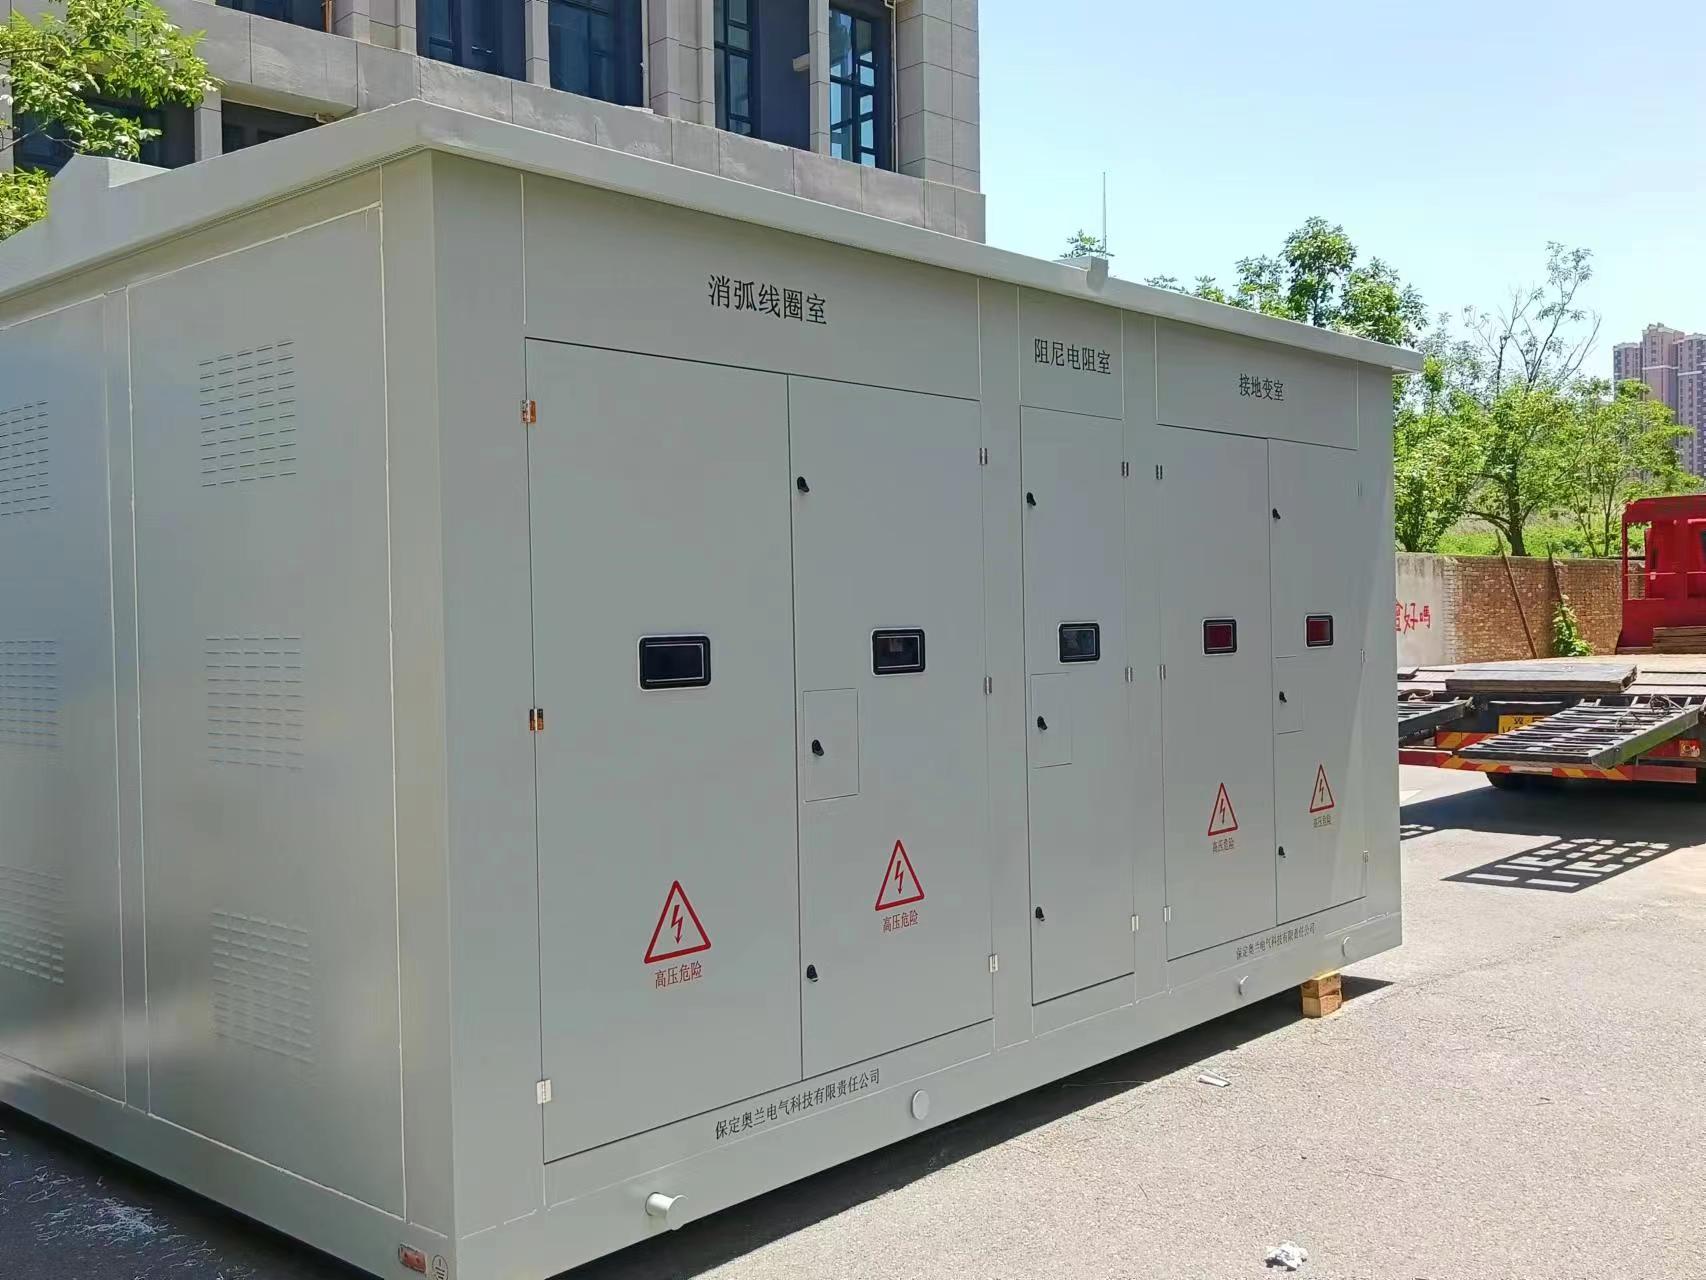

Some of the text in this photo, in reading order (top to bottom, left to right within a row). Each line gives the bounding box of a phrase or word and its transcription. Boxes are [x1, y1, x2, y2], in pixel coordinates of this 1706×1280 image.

[708, 274, 827, 325] 消弧线圈室
[1034, 338, 1111, 375] 阻尼电阻室
[1239, 373, 1285, 402] 接地变室
[882, 910, 919, 933] 高压危险
[654, 960, 703, 989] 高压危险
[715, 1068, 880, 1140] 保定奥兰电气科技有限责任公司
